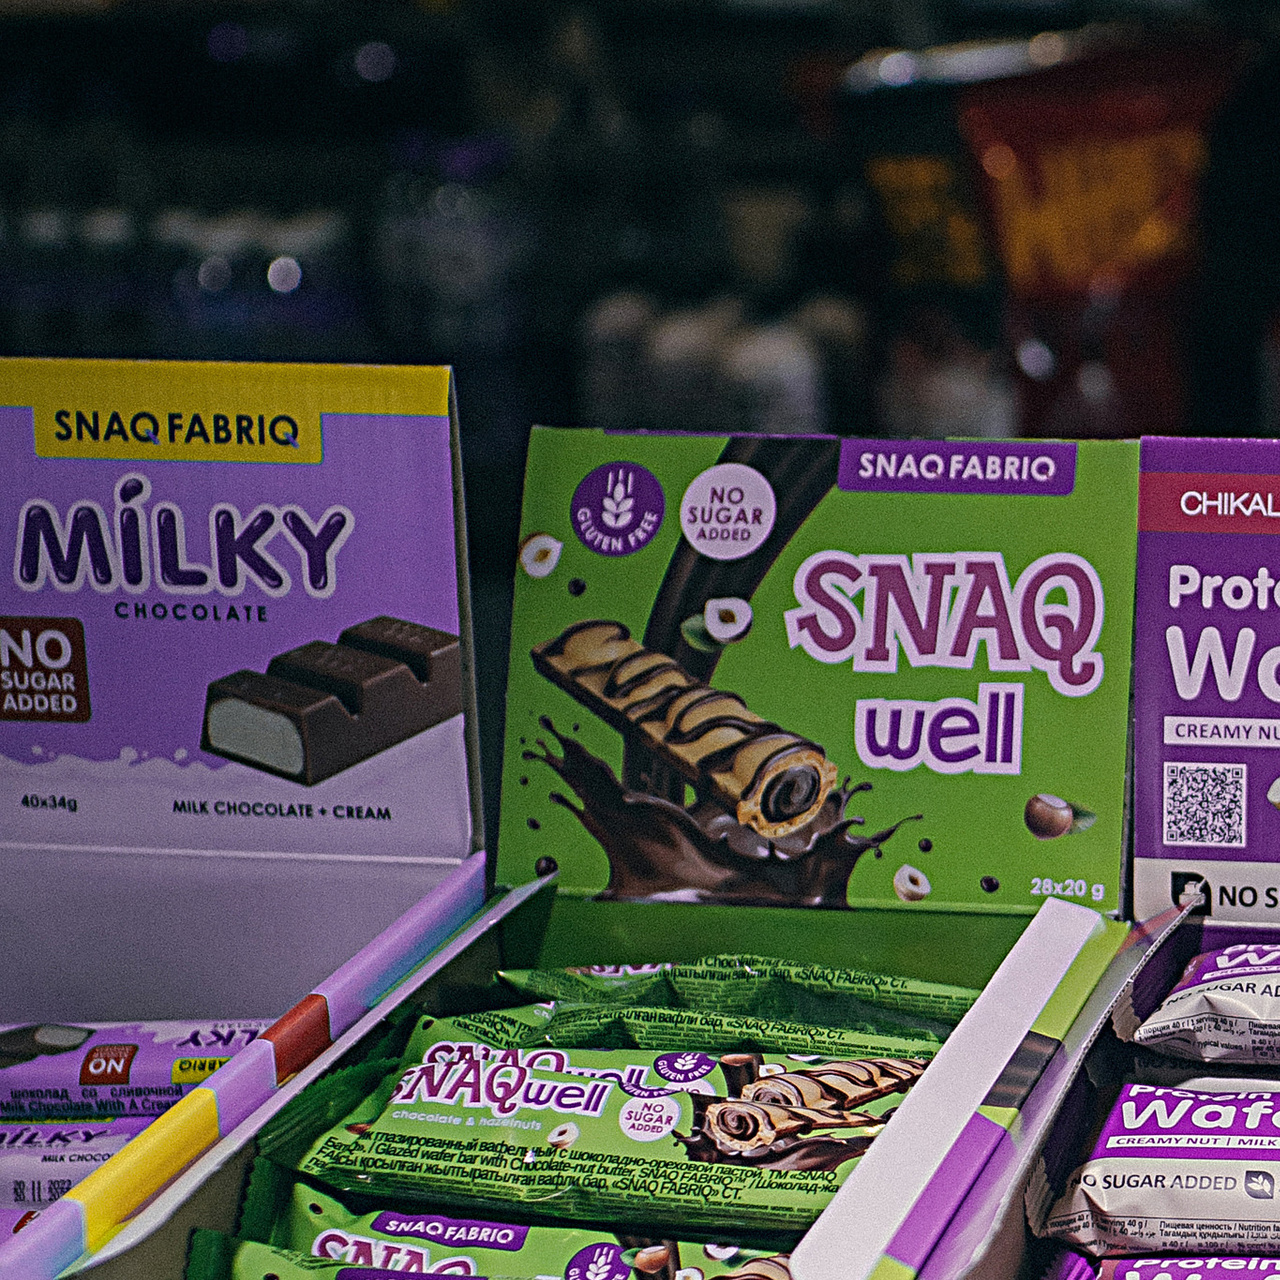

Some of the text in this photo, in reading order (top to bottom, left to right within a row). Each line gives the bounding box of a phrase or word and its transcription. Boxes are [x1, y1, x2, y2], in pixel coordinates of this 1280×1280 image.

[55, 409, 299, 448] SNAQ FABRIQ
[710, 487, 744, 505] NO
[688, 507, 763, 525] SUGAR
[577, 507, 659, 551] GLUTEN FREE
[697, 527, 751, 541] ADDED
[115, 601, 268, 622] CHOCOLATE
[795, 554, 1102, 691] SNAQ
[1, 630, 72, 669] NO
[1, 671, 75, 692] SUGAR
[3, 693, 77, 714] ADDED
[862, 688, 1018, 768] well
[1175, 724, 1253, 743] CREAMY
[173, 799, 391, 820] MILK CHOCOLATE CREAM
[1029, 877, 1105, 901] 28x20 g
[1218, 887, 1257, 908] NO
[1204, 982, 1257, 995] SUGAR
[641, 1101, 664, 1114] NO
[392, 1110, 542, 1131] chocolate hazelnuts
[624, 1111, 674, 1126] SUGAR
[629, 1122, 663, 1134] ADDED
[376, 1144, 418, 1159] Glazed
[1116, 1137, 1183, 1146] CREAMY
[1187, 1137, 1220, 1146] NUT
[1238, 1139, 1278, 1148] MILK
[1102, 1174, 1237, 1190] SUGAR ADDED
